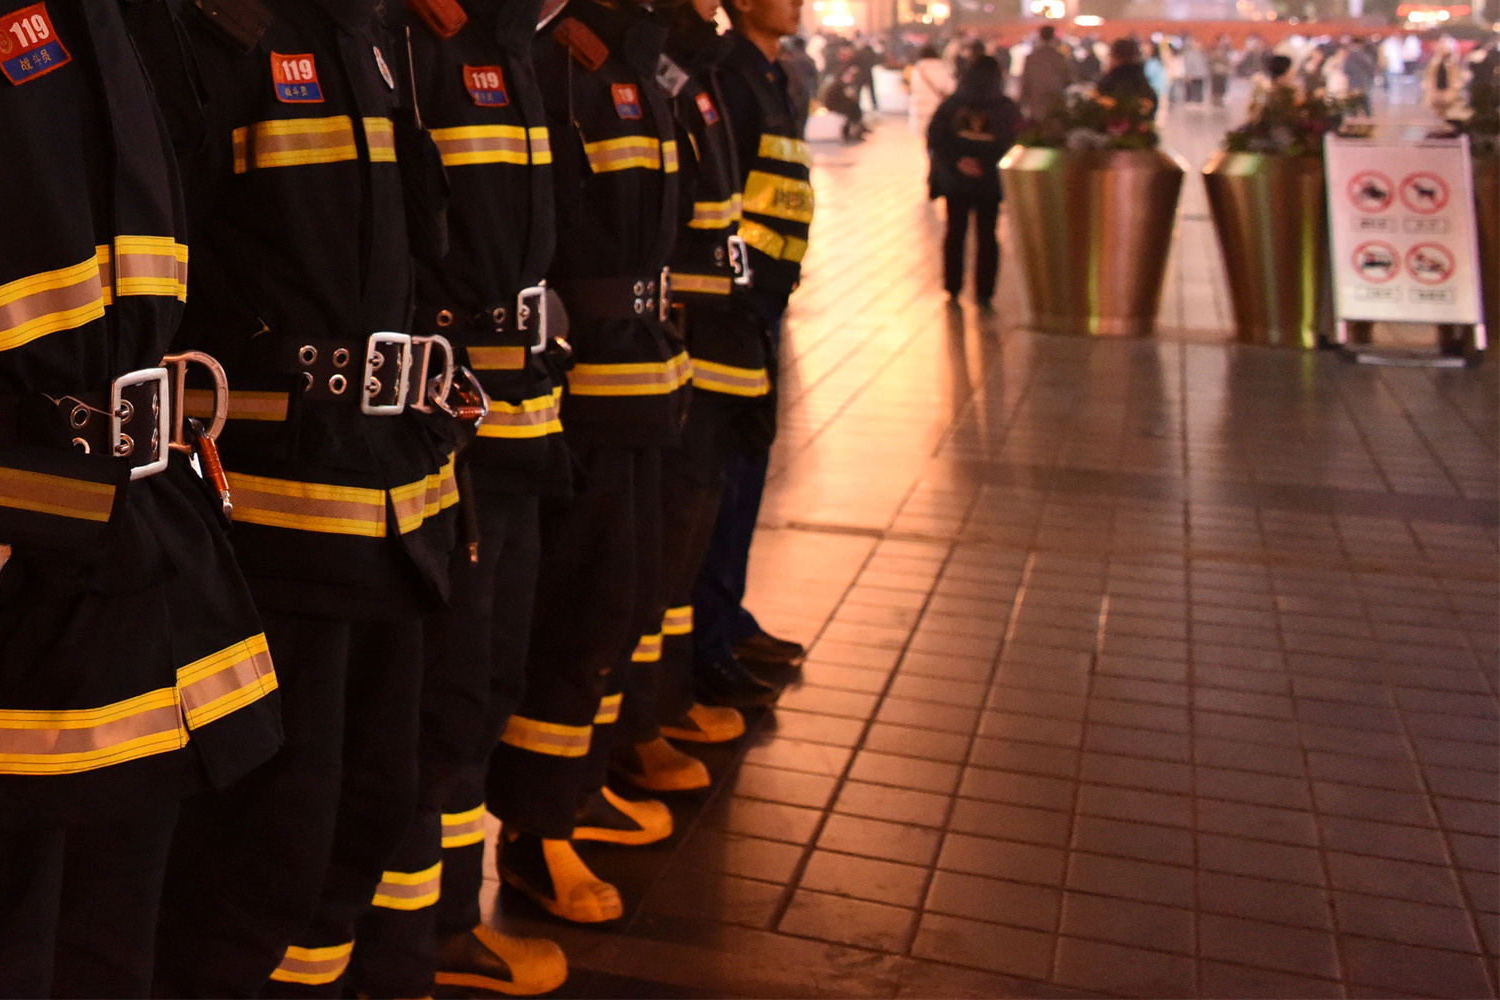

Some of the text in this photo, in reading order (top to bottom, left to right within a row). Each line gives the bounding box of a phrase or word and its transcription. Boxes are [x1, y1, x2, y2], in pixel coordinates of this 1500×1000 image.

[9, 13, 50, 48] 119
[19, 48, 52, 72] 战斗员
[281, 59, 314, 81] 119
[471, 71, 500, 89] 119
